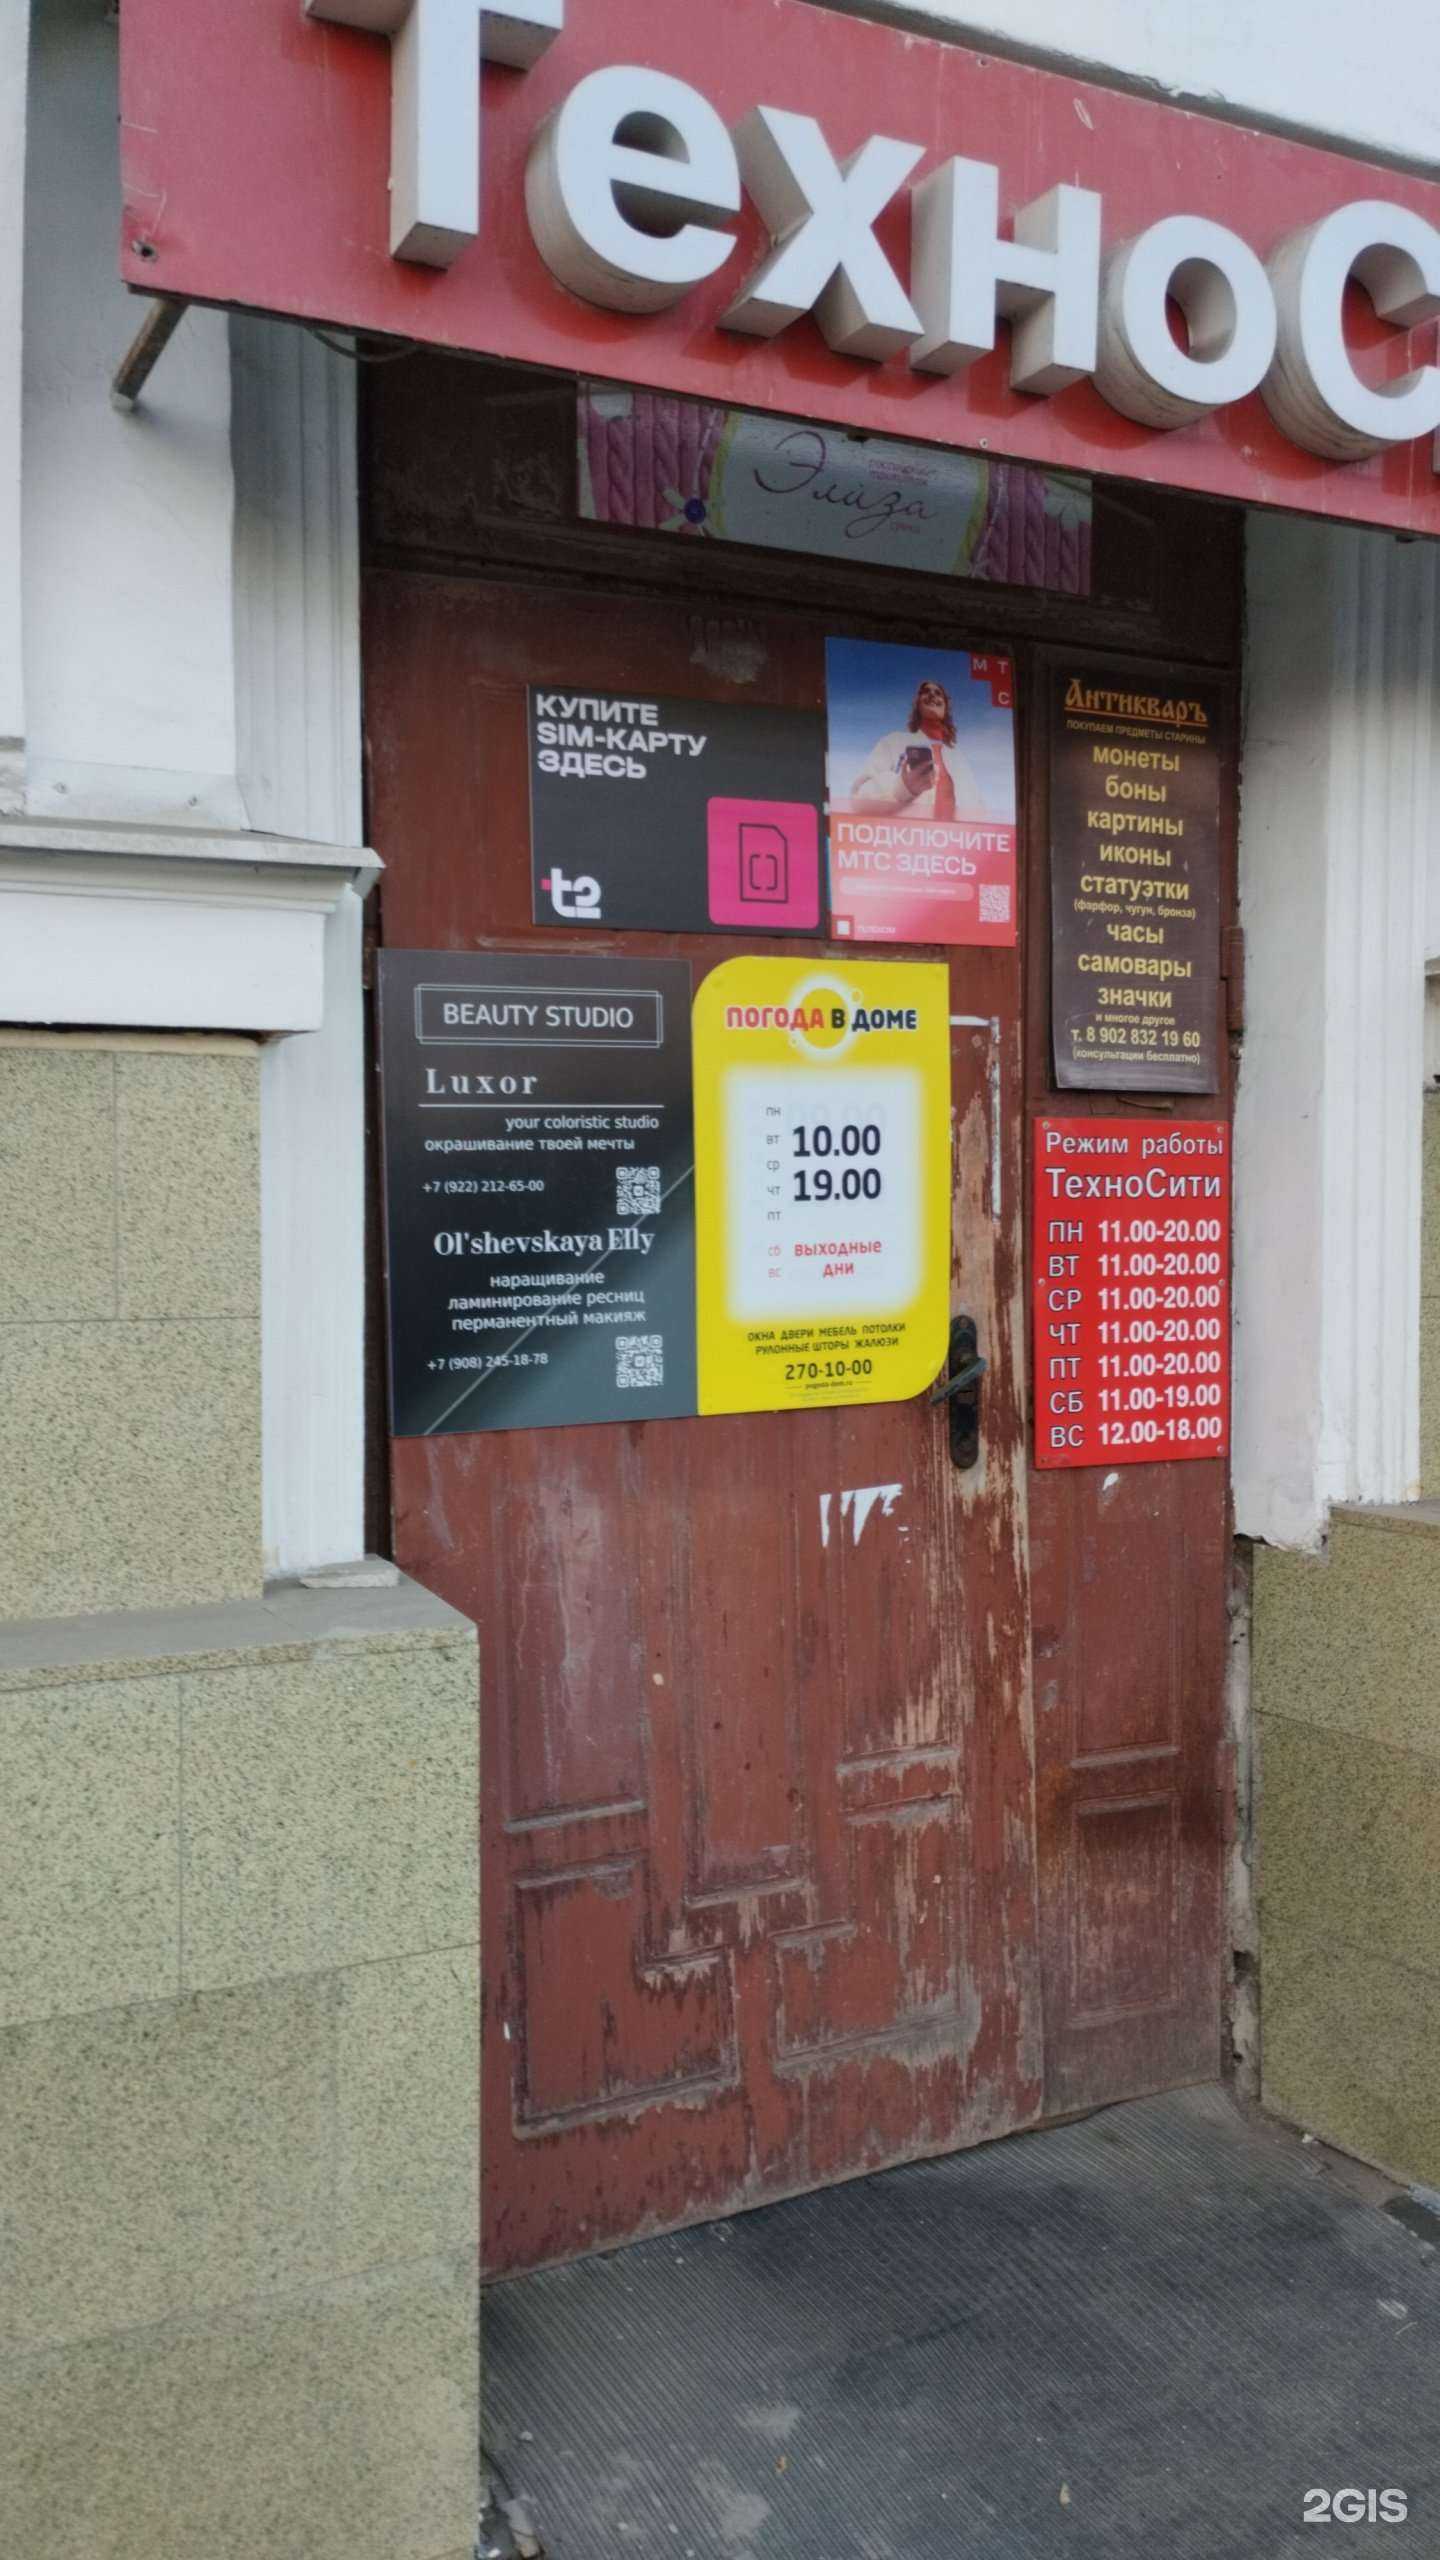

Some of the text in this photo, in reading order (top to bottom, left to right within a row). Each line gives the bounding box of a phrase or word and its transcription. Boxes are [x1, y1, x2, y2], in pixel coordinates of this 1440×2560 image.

[535, 694, 658, 727] КУПИТЕ
[536, 722, 706, 757] SIM-КАРТУ
[1066, 719, 1206, 745] ПОКУПАЕМ ПРЕДМЕТЫ СТАРИНЫ
[537, 749, 647, 779] ЗДЕСЬ
[1093, 746, 1180, 772] монеты
[1105, 774, 1167, 802] боны
[1087, 810, 1184, 836] картины
[837, 823, 1011, 852] ПОДКЛЮЧИТЕ
[838, 849, 977, 876] МТС ЗДЕСЬ
[1100, 844, 1171, 867] иконы
[541, 867, 602, 919] t2
[1080, 874, 1189, 901] статуэтки
[1074, 898, 1196, 920] (фарфор, чугун, бронза)
[1106, 923, 1164, 944] часы
[1078, 953, 1192, 981] самовары
[1097, 987, 1172, 1008] значки
[443, 1003, 634, 1028] BEAUTY STUDIO
[727, 1007, 917, 1032] ПОГОДА В ДОМЕ
[1104, 1014, 1140, 1024] многое
[1142, 1016, 1176, 1027] другое
[1071, 1026, 1201, 1047] т. 8 902 832 19 60
[1073, 1047, 1144, 1061] (консультации
[425, 1068, 539, 1094] Luxor
[505, 1115, 660, 1132] your coloristic studio
[424, 1136, 635, 1154] окрашивание твоей мечты
[792, 1124, 881, 1157] 10.00
[1045, 1131, 1223, 1159] Режим работы
[422, 1180, 545, 1194] +7 (922) 212-65-00
[793, 1168, 881, 1201] 19.00
[1045, 1168, 1221, 1199] ТехноСити
[434, 1227, 655, 1257] Ol'shevskaya Elly
[1048, 1219, 1221, 1243] ПН 11.00-20.00
[1048, 1252, 1221, 1277] ВТ 11.00-20.00
[490, 1271, 605, 1290] наращивание
[448, 1290, 646, 1310] ламинирование ресниц
[1048, 1285, 1221, 1312] СР 11.00-20.00
[452, 1311, 646, 1333] перманентный макияж
[747, 1323, 906, 1342] ОКНА ДВЕРИ МЕБЕЛЬ ПОТОЛКИ
[1049, 1318, 1221, 1345] ЧТ 11.00-20.00
[755, 1337, 899, 1355] РУЛОННЫЕ ШТОРЫ ЖАЛЮЗИ
[427, 1358, 445, 1370] +7
[448, 1356, 482, 1371] (908)
[785, 1359, 872, 1380] 270-10-00
[1049, 1351, 1221, 1379] ПТ 11.00-20.00
[1050, 1384, 1221, 1414] СБ 11.00-19.00
[1050, 1416, 1222, 1448] ВС 12.00-18.00
